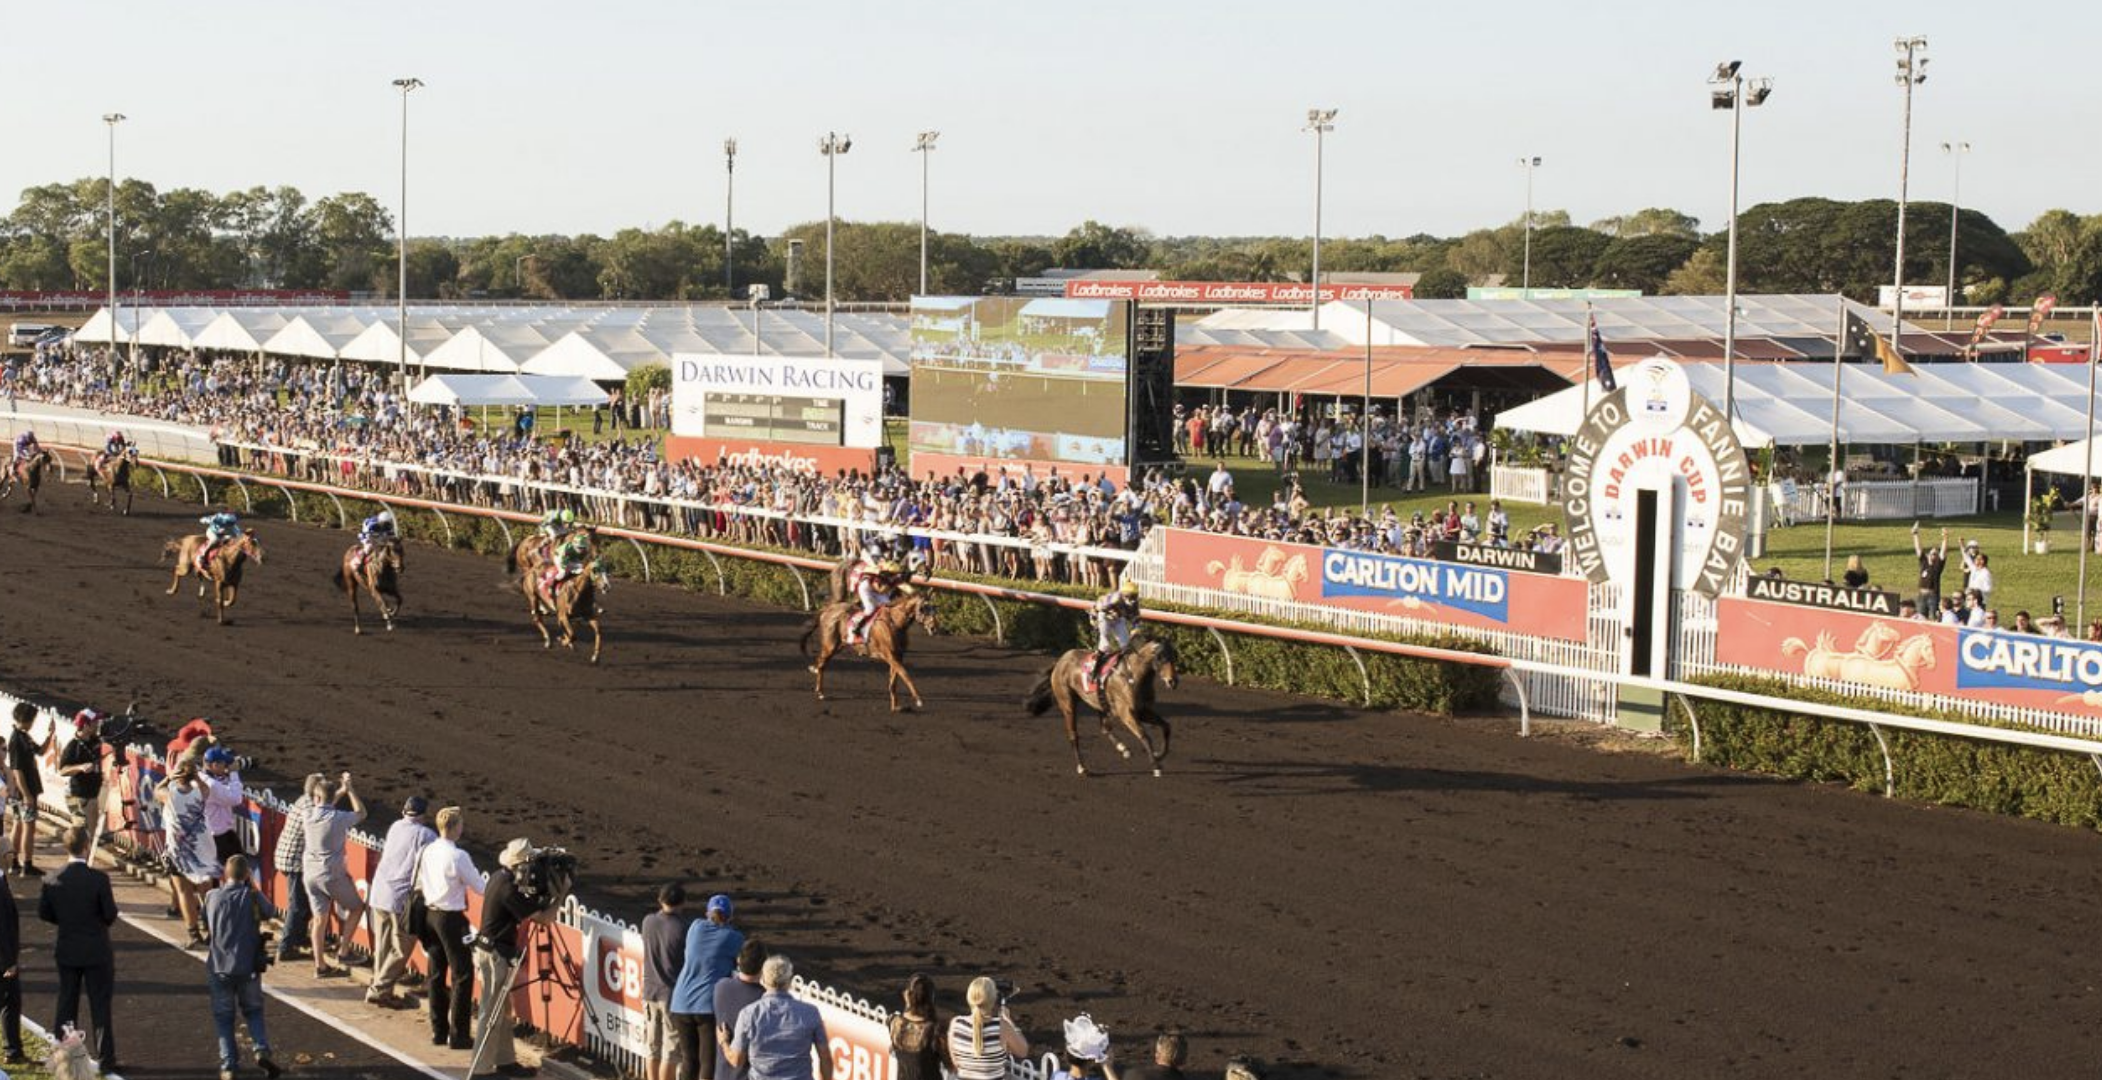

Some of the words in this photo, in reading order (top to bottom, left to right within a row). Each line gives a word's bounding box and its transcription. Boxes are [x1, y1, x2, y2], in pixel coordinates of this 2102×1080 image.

[1072, 283, 1133, 297] Ladbrokes
[1138, 284, 1199, 298] Ladbrokes
[1204, 285, 1267, 299] Ladbrokes
[1272, 286, 1334, 300] Ladbroes
[1340, 287, 1404, 300] Ladbrokes
[681, 360, 773, 386] DARWIN
[783, 365, 874, 391] RACING
[1590, 401, 1620, 434] TO
[1604, 437, 1674, 499] DARWIN
[1679, 455, 1707, 504] CUP
[1690, 404, 1745, 517] FANNIE
[1567, 434, 1601, 575] WELCOME
[1324, 552, 1439, 596] CARLTON
[1446, 568, 1505, 604] MID
[1456, 545, 1536, 570] DARWIN
[1701, 530, 1738, 590] BAY
[1753, 579, 1890, 613] AUSTRALIA
[1960, 633, 2102, 686] CARLTO
[604, 950, 641, 999] GB
